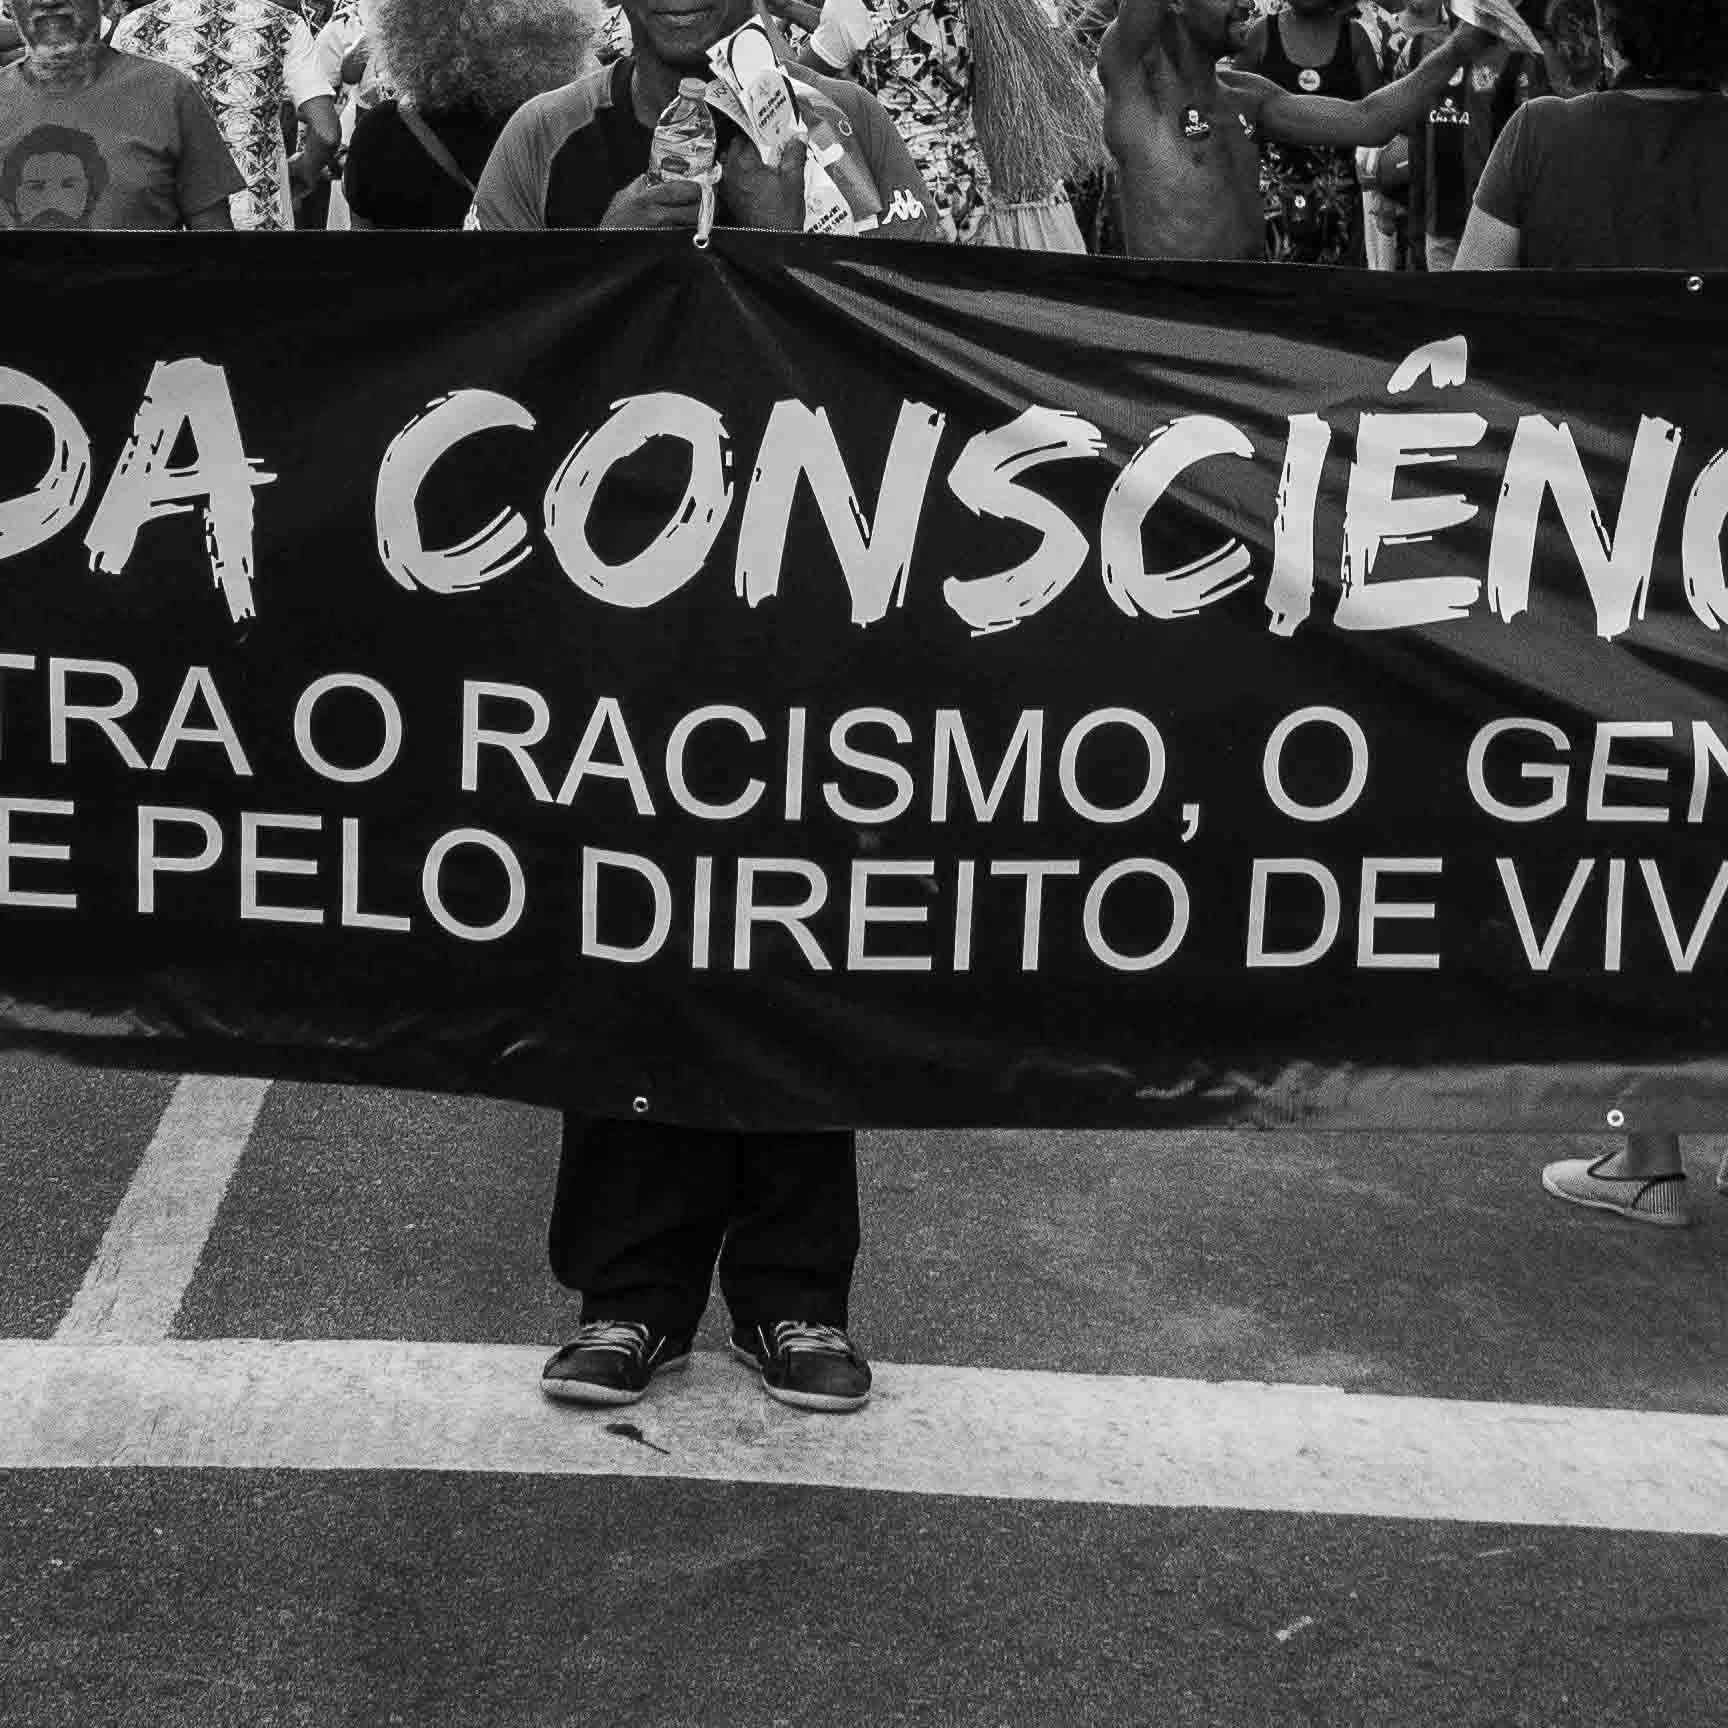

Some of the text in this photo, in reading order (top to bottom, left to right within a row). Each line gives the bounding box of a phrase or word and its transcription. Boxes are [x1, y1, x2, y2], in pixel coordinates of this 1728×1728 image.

[294, 674, 401, 782] O
[460, 680, 1199, 841] RACISMO,
[1263, 707, 1368, 821] O
[138, 806, 525, 940] PELO
[582, 849, 1192, 970] DIREITO
[1247, 858, 1442, 968] DE
